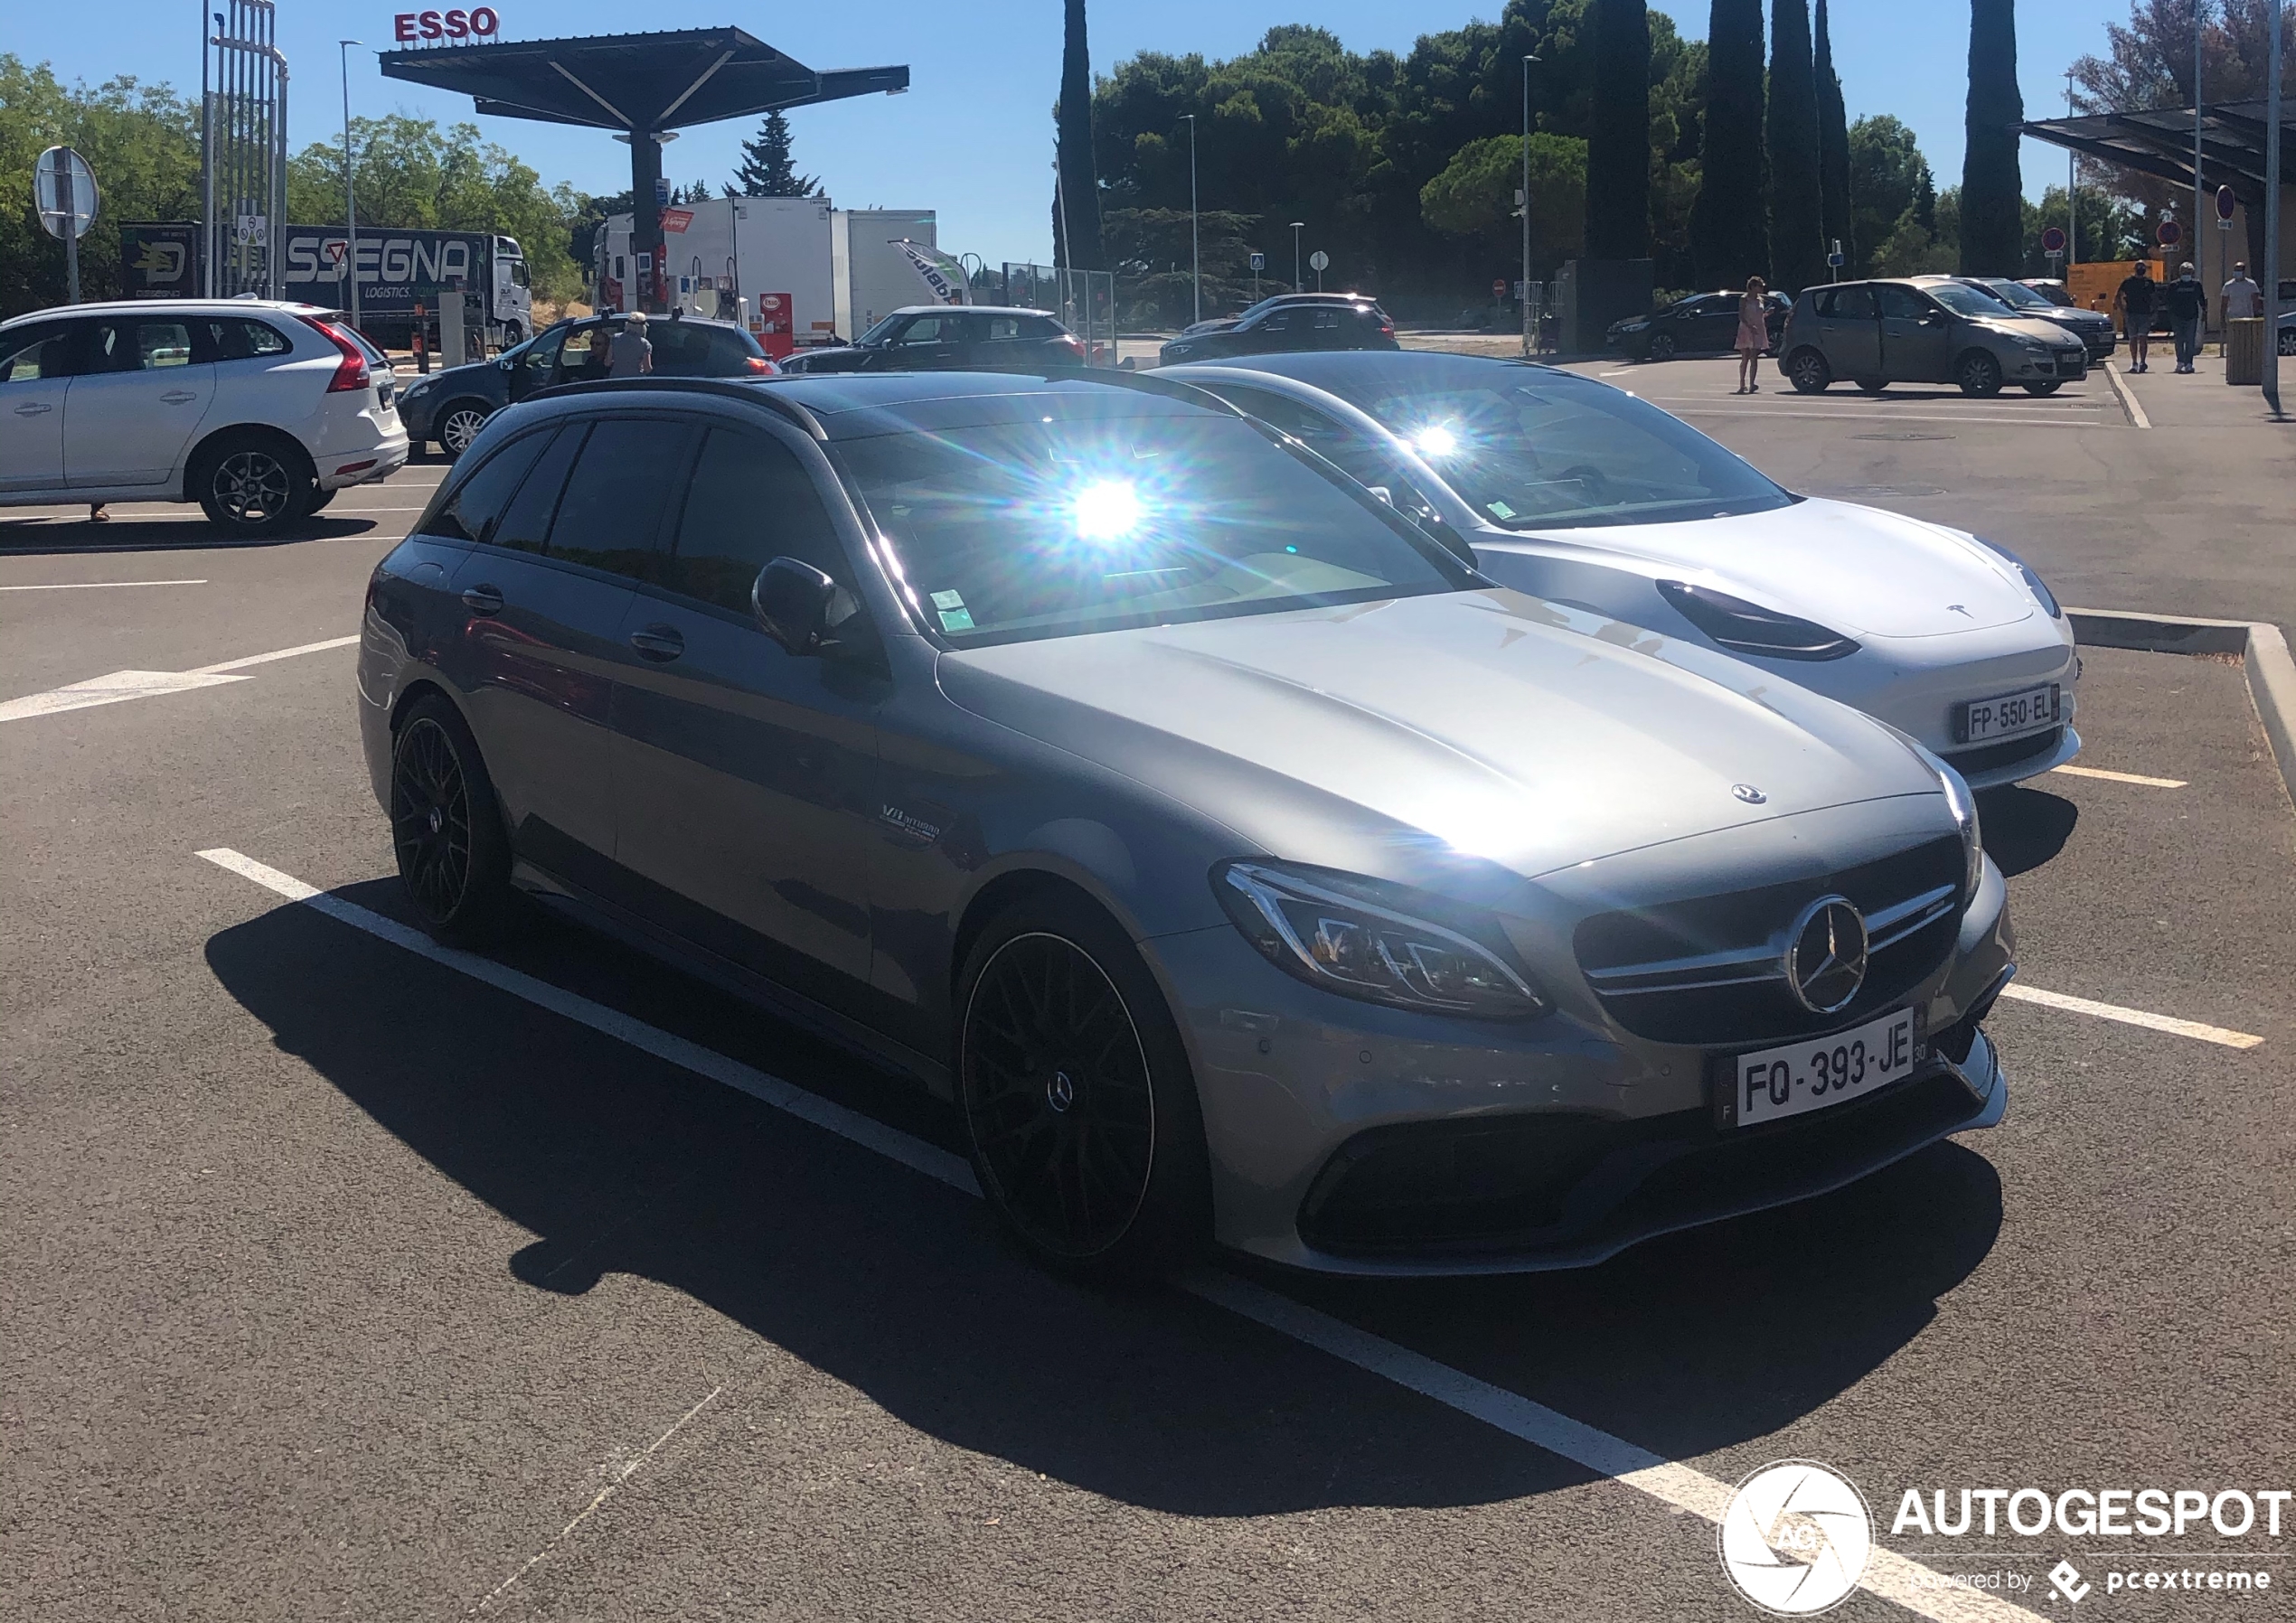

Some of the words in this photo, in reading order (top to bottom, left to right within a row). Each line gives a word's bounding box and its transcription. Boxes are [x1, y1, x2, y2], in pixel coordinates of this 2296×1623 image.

[395, 6, 499, 42] ESSO
[1971, 694, 2050, 735] FP-550-EL
[1746, 1020, 1908, 1112] FQ-393-JE
[1914, 1044, 1926, 1063] 30
[1722, 1105, 1730, 1121] F
